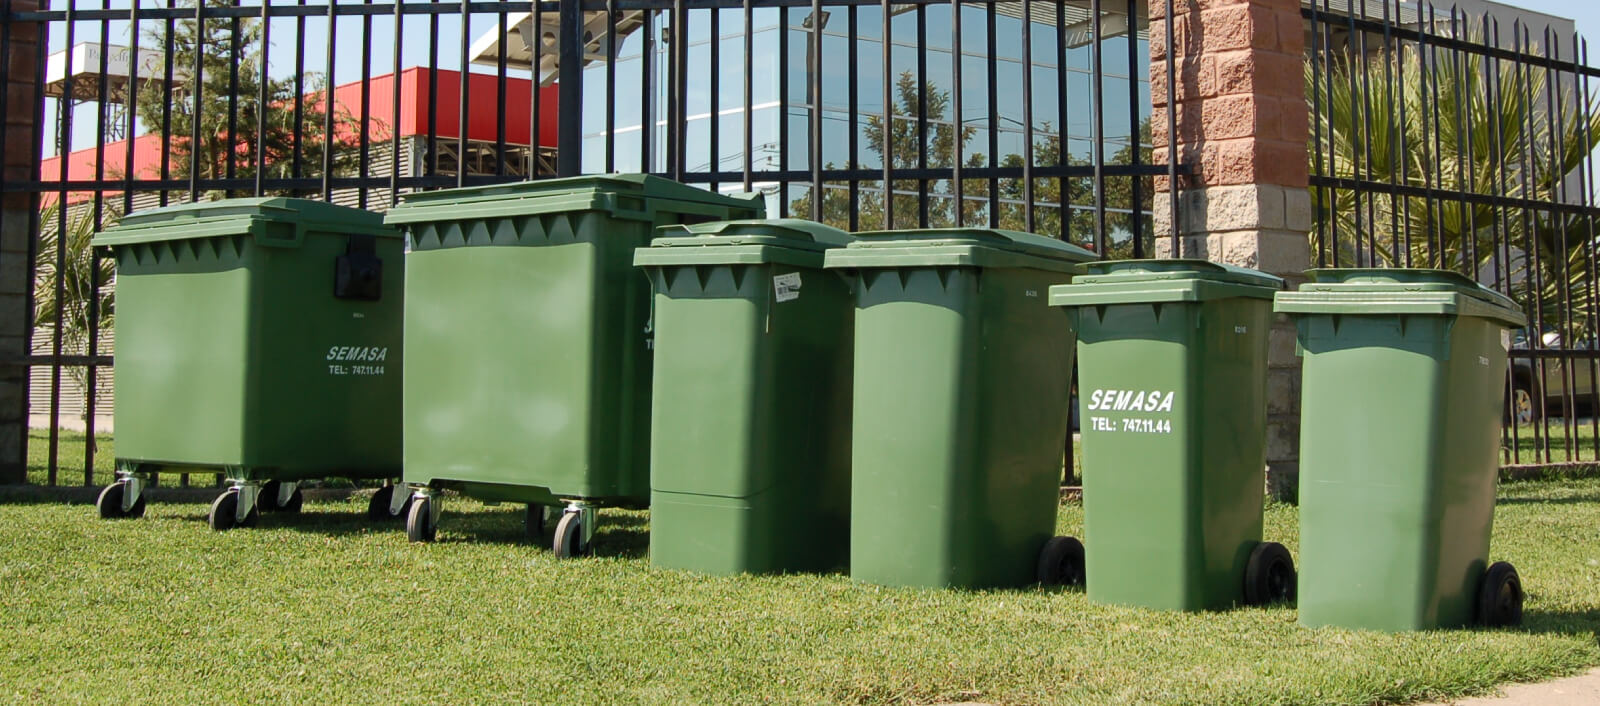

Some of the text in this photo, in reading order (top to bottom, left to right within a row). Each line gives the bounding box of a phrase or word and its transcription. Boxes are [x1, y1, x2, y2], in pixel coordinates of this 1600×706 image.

[326, 346, 388, 361] SEMASA
[328, 365, 385, 375] TEL: 747.11.44
[1087, 389, 1175, 412] SEMASA
[1091, 417, 1172, 433] TEL: 747.11.44
